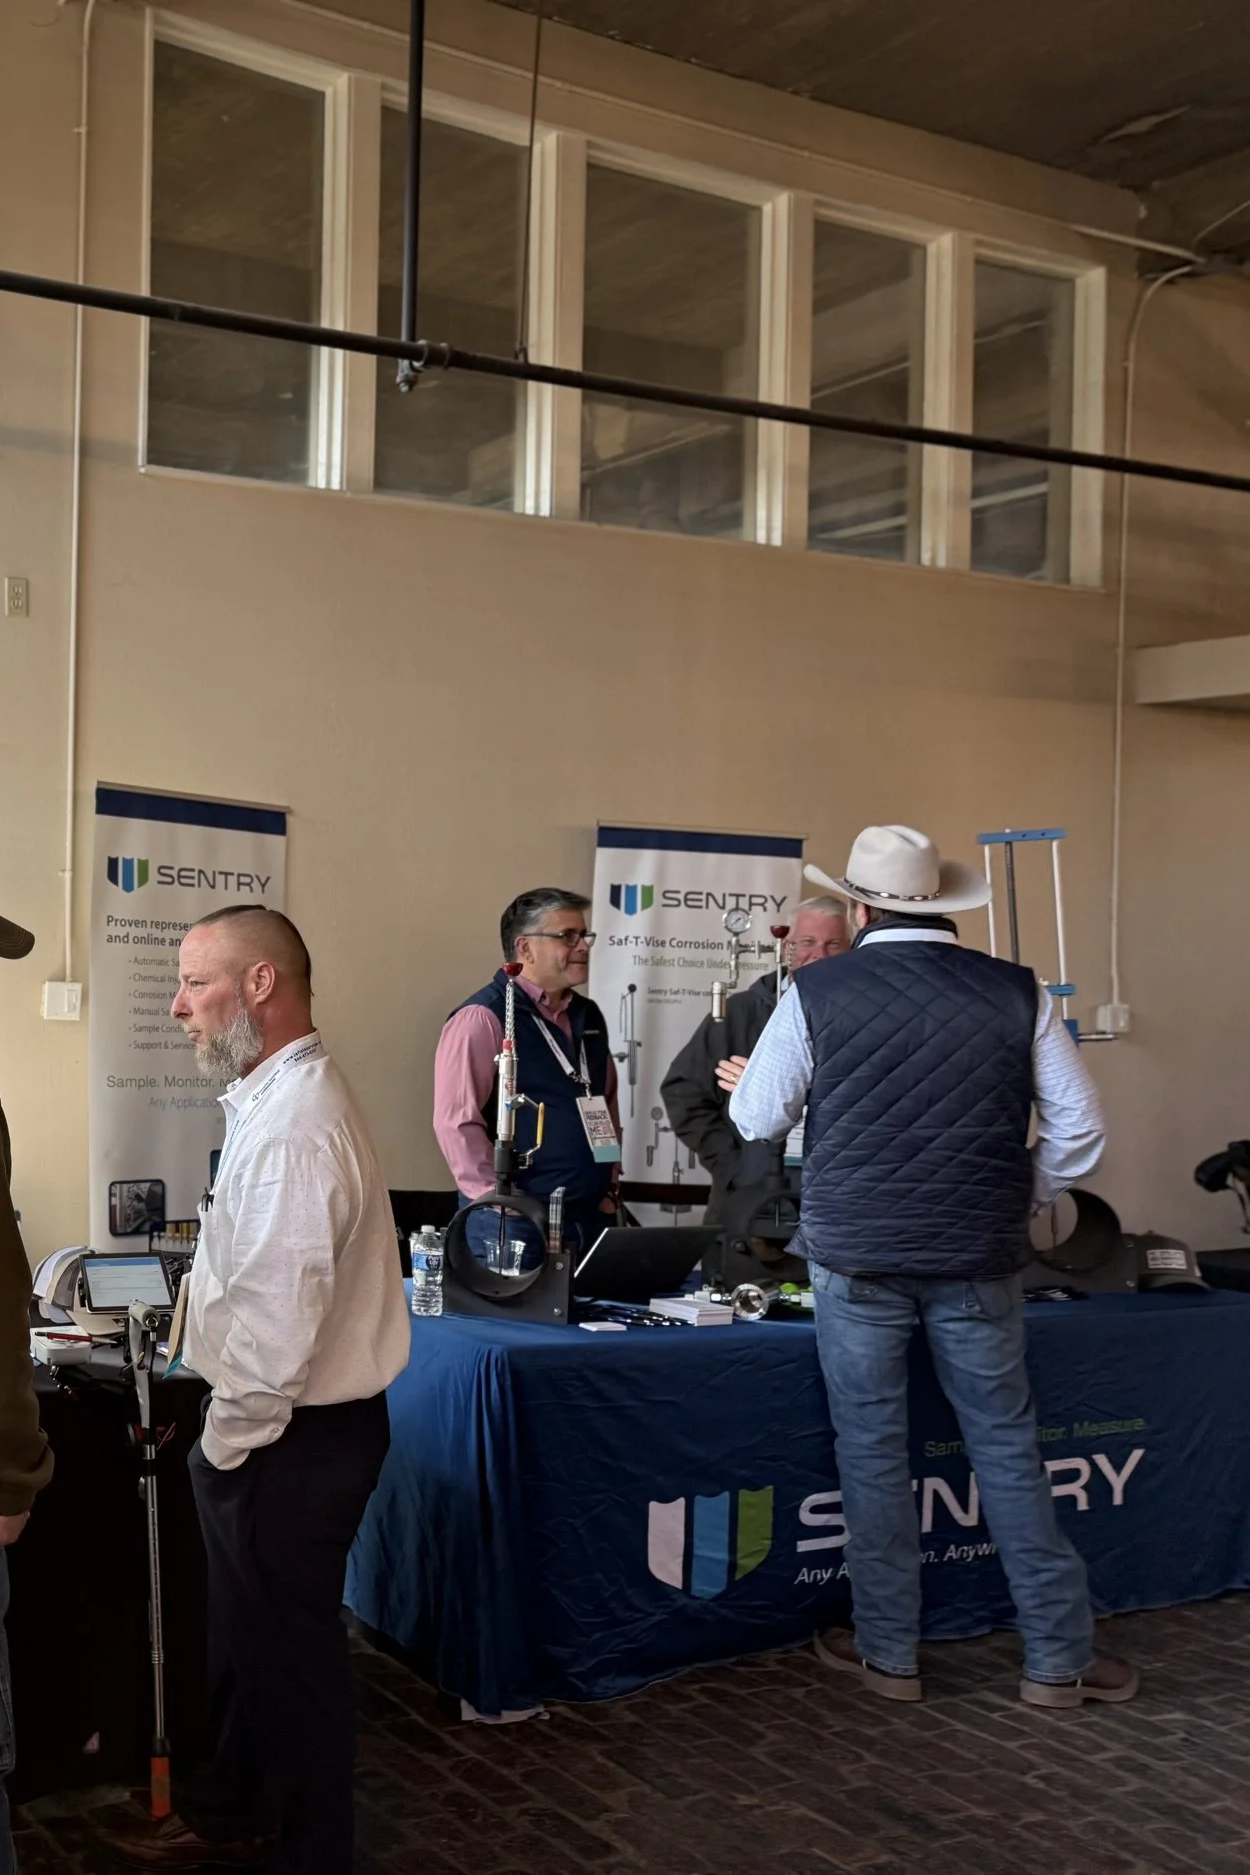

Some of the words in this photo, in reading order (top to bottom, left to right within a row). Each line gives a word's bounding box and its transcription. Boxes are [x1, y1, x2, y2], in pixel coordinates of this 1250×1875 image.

[157, 865, 271, 895] SENTRY
[661, 889, 789, 913] SENTRY
[106, 915, 147, 929] Proven
[106, 932, 129, 944] and
[132, 933, 166, 947] online
[169, 937, 182, 947] an
[608, 936, 666, 949] Saf-T-Vise
[669, 937, 724, 950] Corrosion
[133, 957, 170, 967] Automatic
[633, 955, 648, 967] The
[650, 956, 675, 968] Safest
[677, 957, 704, 968] Choice
[736, 960, 769, 971] ressure
[133, 973, 166, 983] Chemical
[133, 990, 168, 1000] Corrosion
[133, 1007, 160, 1016] Manual
[161, 1008, 170, 1016] Sa
[133, 1024, 160, 1034] Sample
[133, 1041, 162, 1051] Support
[106, 1075, 159, 1089] Sample.
[164, 1076, 215, 1088] Monitor.
[150, 1097, 167, 1111] Any
[925, 1439, 964, 1459] Sam
[1073, 1416, 1146, 1439] Measure
[794, 1566, 832, 1585] Any
[943, 1542, 997, 1563] Anyw
